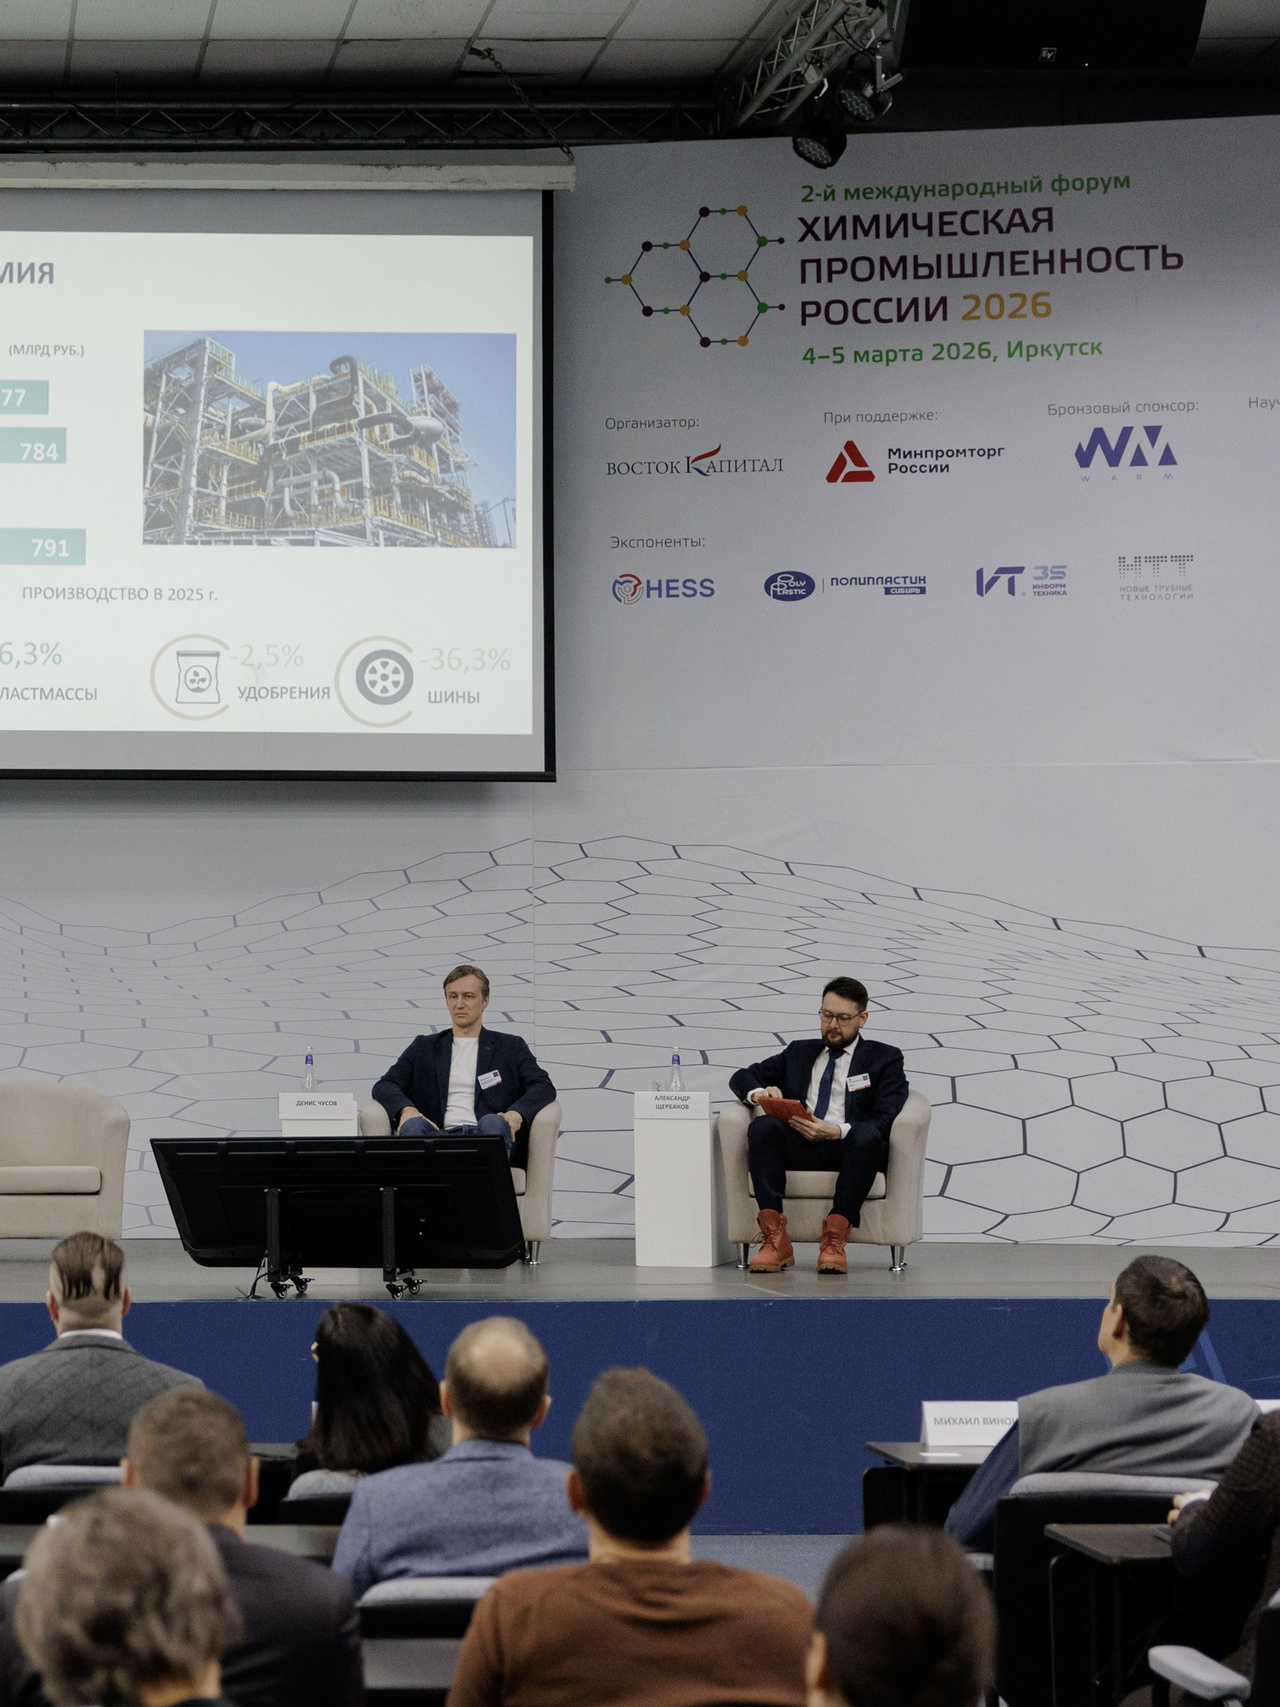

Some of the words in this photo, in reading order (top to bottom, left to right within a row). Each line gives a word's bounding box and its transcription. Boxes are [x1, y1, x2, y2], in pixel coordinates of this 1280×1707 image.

[801, 184, 836, 202] 2-й
[844, 176, 1042, 202] международный
[1050, 173, 1131, 196] форум
[798, 206, 1053, 242] ХИМИЧЕСКАЯ
[800, 244, 1184, 284] ПРОМЫШЛЕННОСТЬ
[800, 296, 948, 326] РОССИИ
[961, 291, 1052, 321] 2026
[8, 344, 51, 358] (МЛРД
[53, 344, 85, 358] РУБ.)
[853, 347, 924, 367] марта
[931, 341, 997, 363] 2026,
[1007, 340, 1103, 362] Иркутск
[1047, 402, 1131, 418] Бронзовый
[1135, 400, 1199, 415] спонсор:
[605, 416, 700, 431] Организатор:
[824, 411, 851, 426] При
[856, 410, 939, 425] поддержке:
[20, 442, 59, 461] 784
[887, 445, 1005, 462] Минпромторг
[606, 460, 681, 476] ВОСТОК
[888, 461, 950, 475] России
[31, 538, 70, 557] 791
[610, 535, 705, 550] Экспоненты:
[647, 578, 715, 598] HESS
[830, 575, 927, 586] ПОЛИПЛАСТИК
[1120, 585, 1150, 593] НОВЫЕ
[1154, 584, 1193, 592] ТРУБНЫЕ
[22, 586, 149, 603] ПРОИЗВОДСТВО
[154, 588, 163, 601] В
[167, 588, 204, 601] 2025
[209, 591, 219, 602] г.
[1120, 593, 1194, 601] ТЕХНОЛОГИИ
[230, 643, 304, 670] -2,5%
[420, 647, 512, 674] -36,3%
[237, 686, 331, 702] УДОБРЕНИЯ
[428, 690, 480, 704] ШИНЫ
[933, 1417, 980, 1426] МИХАИЛ
